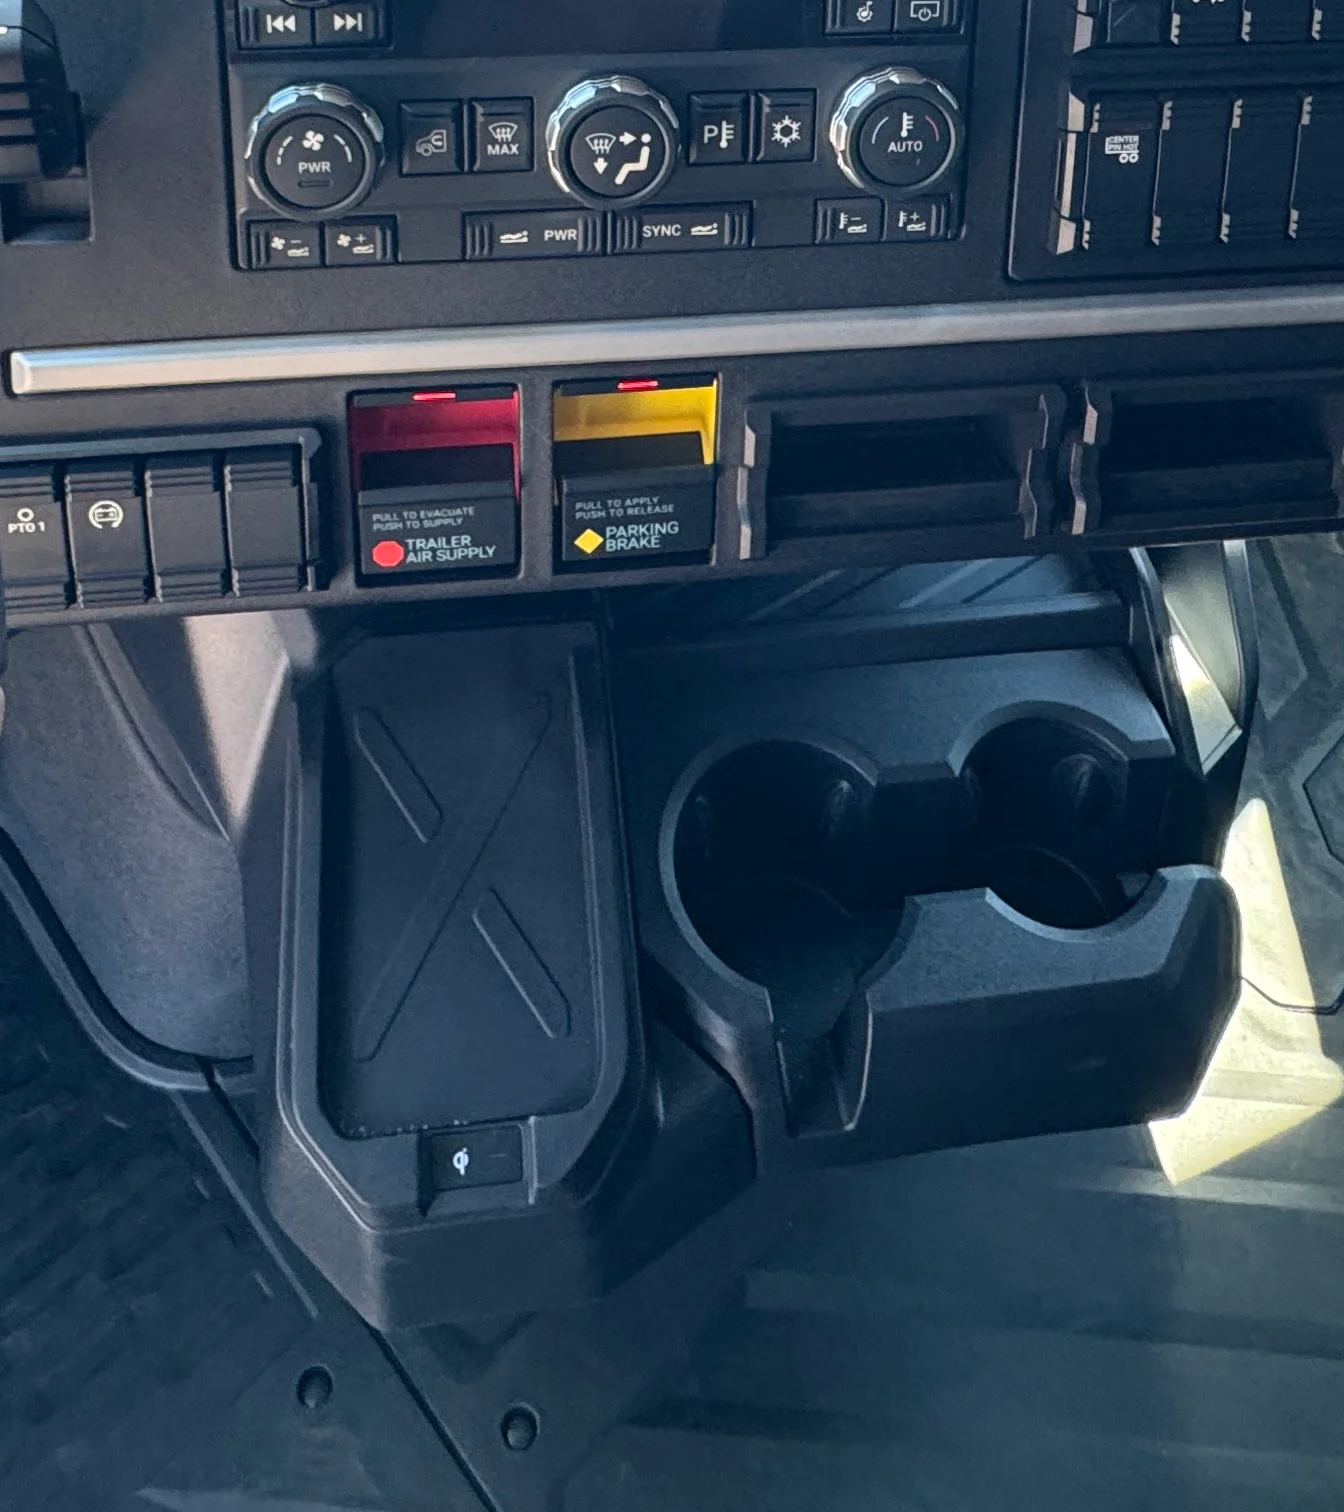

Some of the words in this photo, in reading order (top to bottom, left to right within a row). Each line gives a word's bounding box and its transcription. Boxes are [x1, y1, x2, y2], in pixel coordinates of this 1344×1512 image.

[487, 143, 519, 156] MAX
[887, 140, 923, 154] AUTO
[298, 161, 332, 174] PWR
[544, 228, 577, 241] PWR
[642, 224, 682, 238] SYNC
[575, 500, 603, 511] PULL
[607, 499, 622, 509] TO
[624, 495, 660, 507] APPLY
[372, 512, 399, 522] PULL
[403, 510, 418, 520] TO
[420, 506, 475, 519] EVACUATE
[575, 509, 606, 520] PUSH
[609, 508, 624, 518] TO
[627, 504, 675, 516] RELEASE
[8, 522, 36, 534] PTO
[38, 521, 45, 533] 1
[372, 521, 403, 531] PUSH
[406, 519, 420, 529] TO
[423, 517, 464, 528] SUPPLY
[605, 521, 680, 540] PARKING
[405, 535, 472, 551] TRAILER
[605, 535, 661, 552] BRAKE
[406, 549, 433, 564] AIR
[436, 545, 496, 562] SUPPLY
